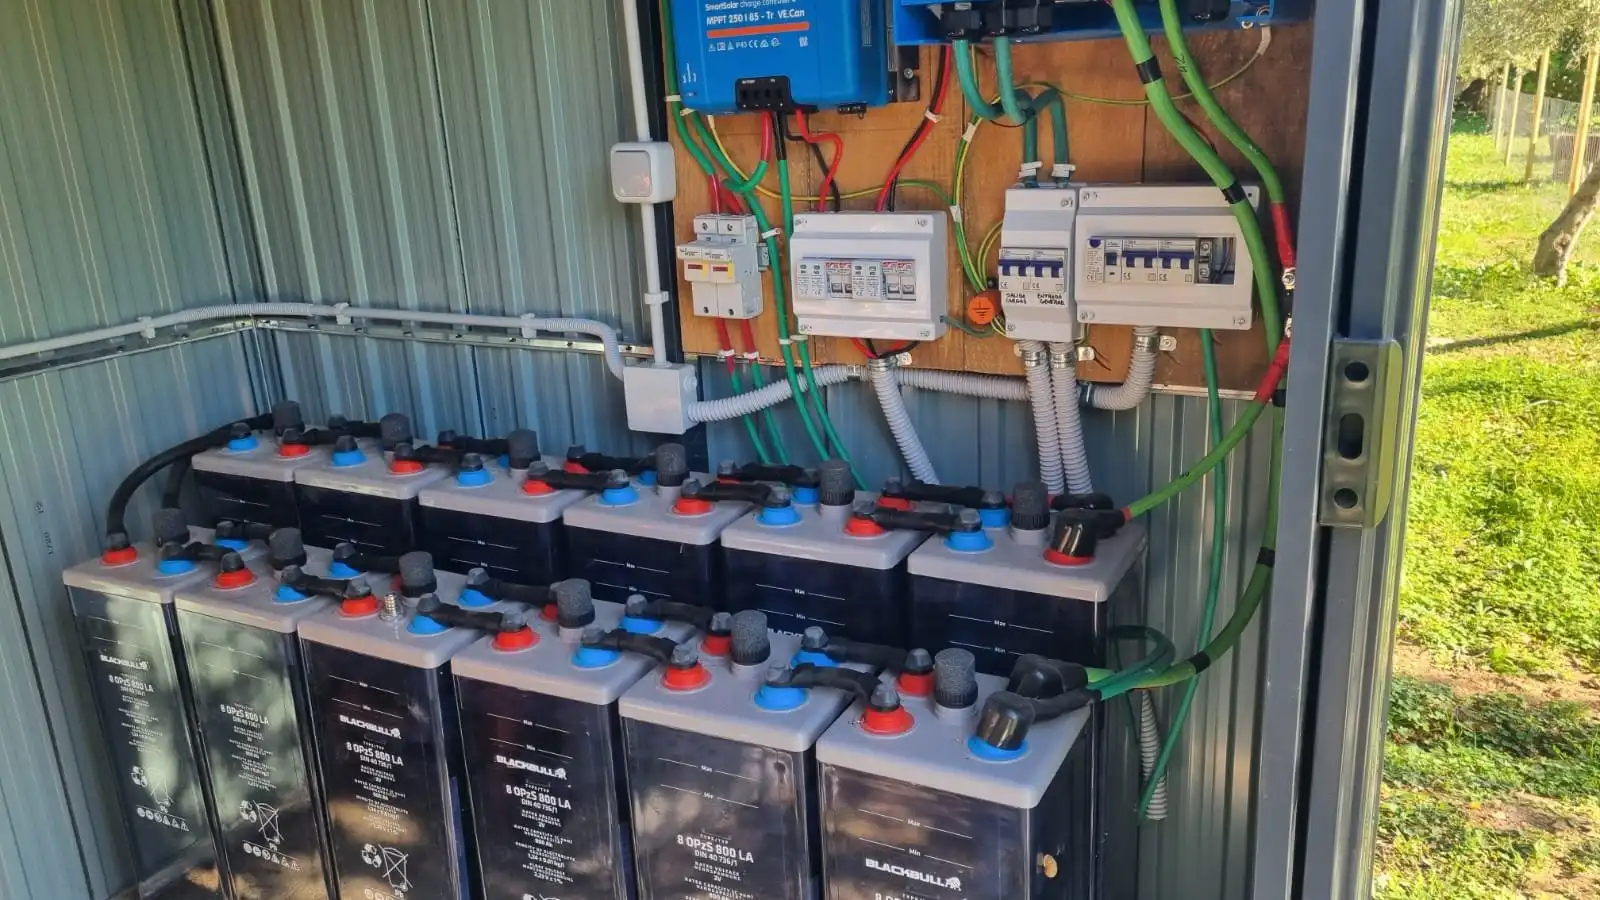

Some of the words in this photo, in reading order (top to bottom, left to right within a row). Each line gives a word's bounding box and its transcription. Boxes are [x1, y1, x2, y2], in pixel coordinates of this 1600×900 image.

[705, 2, 739, 11] SmartSolar
[706, 15, 727, 25] MPPT
[728, 14, 744, 23] 250
[749, 12, 760, 21] 85
[766, 11, 774, 20] Tr
[778, 9, 805, 19] VE.Can
[346, 742, 353, 751] 8
[375, 750, 390, 762] 800
[391, 754, 404, 767] LA
[496, 755, 557, 778] BLACKBULL
[505, 785, 512, 795] 8
[538, 792, 557, 806] 800
[558, 798, 572, 810] LA
[677, 834, 684, 845] 8
[686, 836, 714, 852] OPzS
[715, 844, 737, 859] 800
[738, 849, 755, 864] LA
[694, 849, 708, 859] DIN
[865, 857, 946, 888] BLACKBULL
